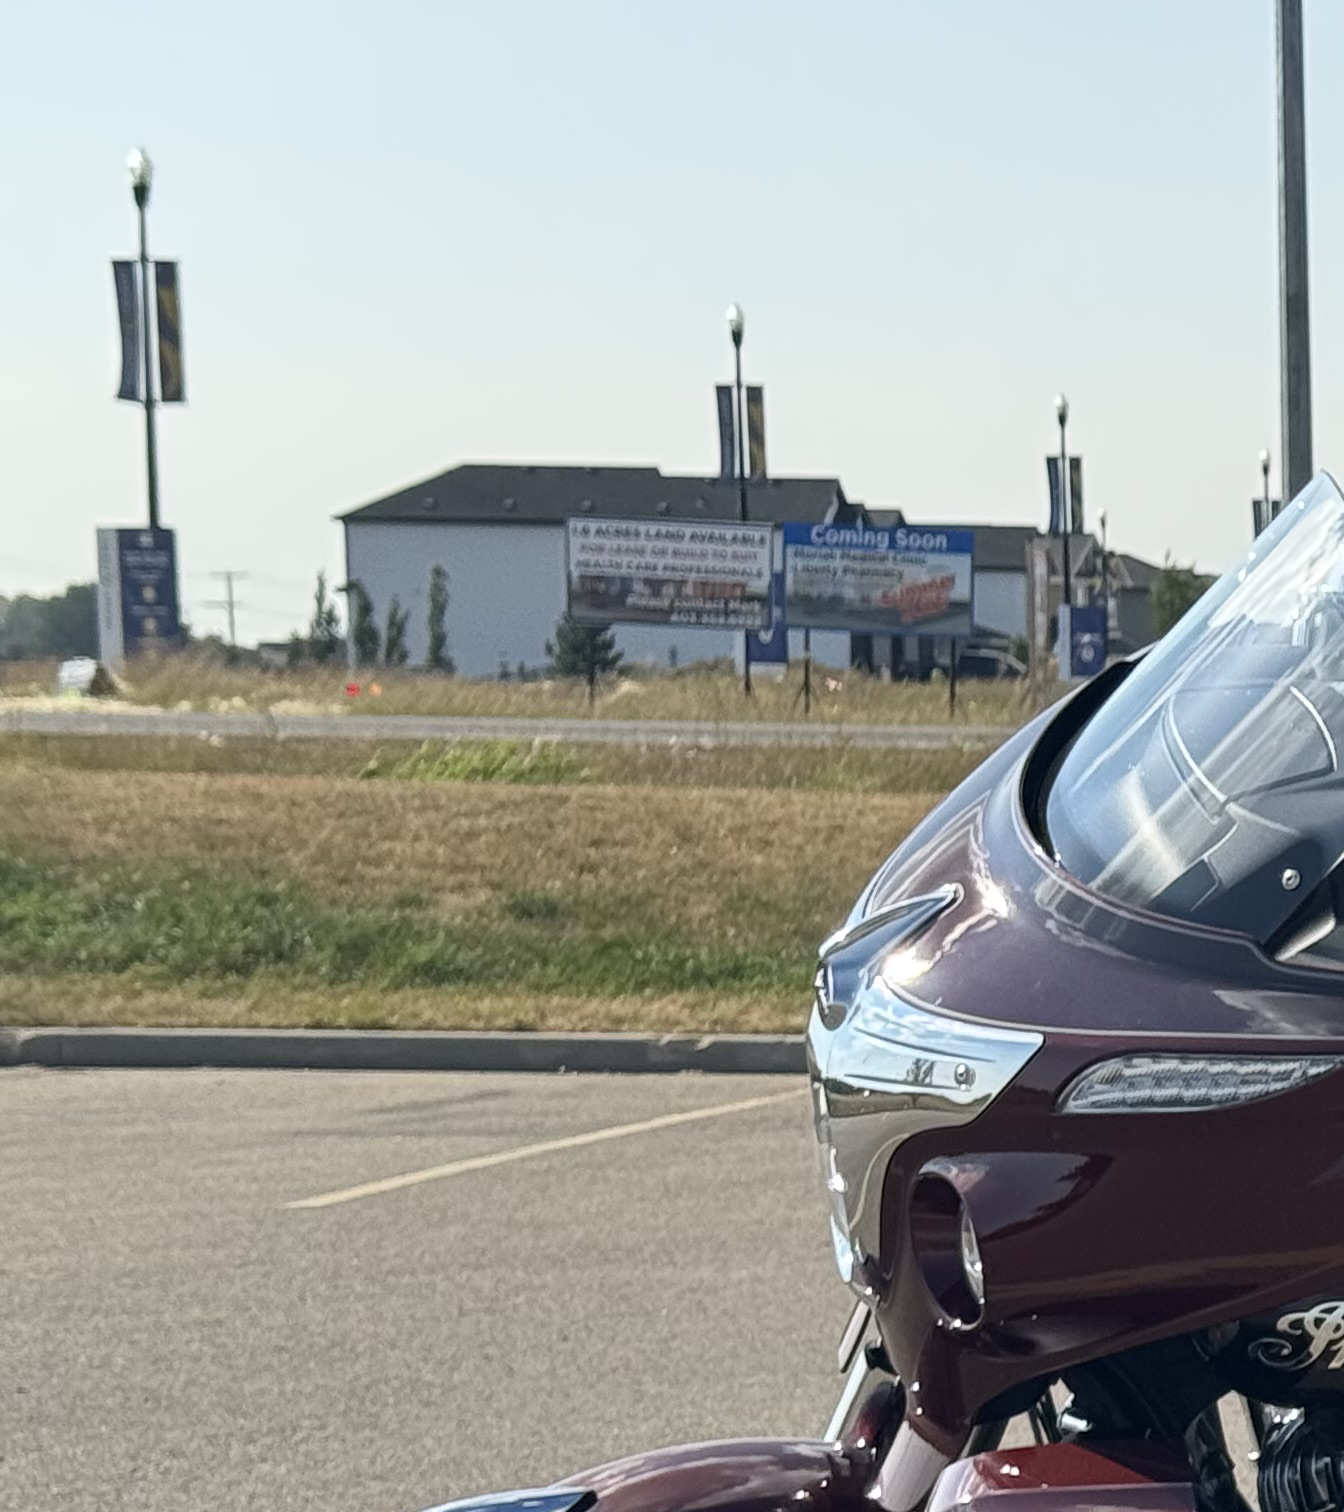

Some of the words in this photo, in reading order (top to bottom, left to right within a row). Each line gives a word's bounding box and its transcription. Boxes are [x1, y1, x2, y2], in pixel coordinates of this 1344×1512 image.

[594, 524, 641, 540] ACRES
[644, 526, 686, 542] LAND
[689, 529, 767, 546] AVAILABLE
[810, 525, 889, 550] Coming
[895, 528, 948, 550] Soon
